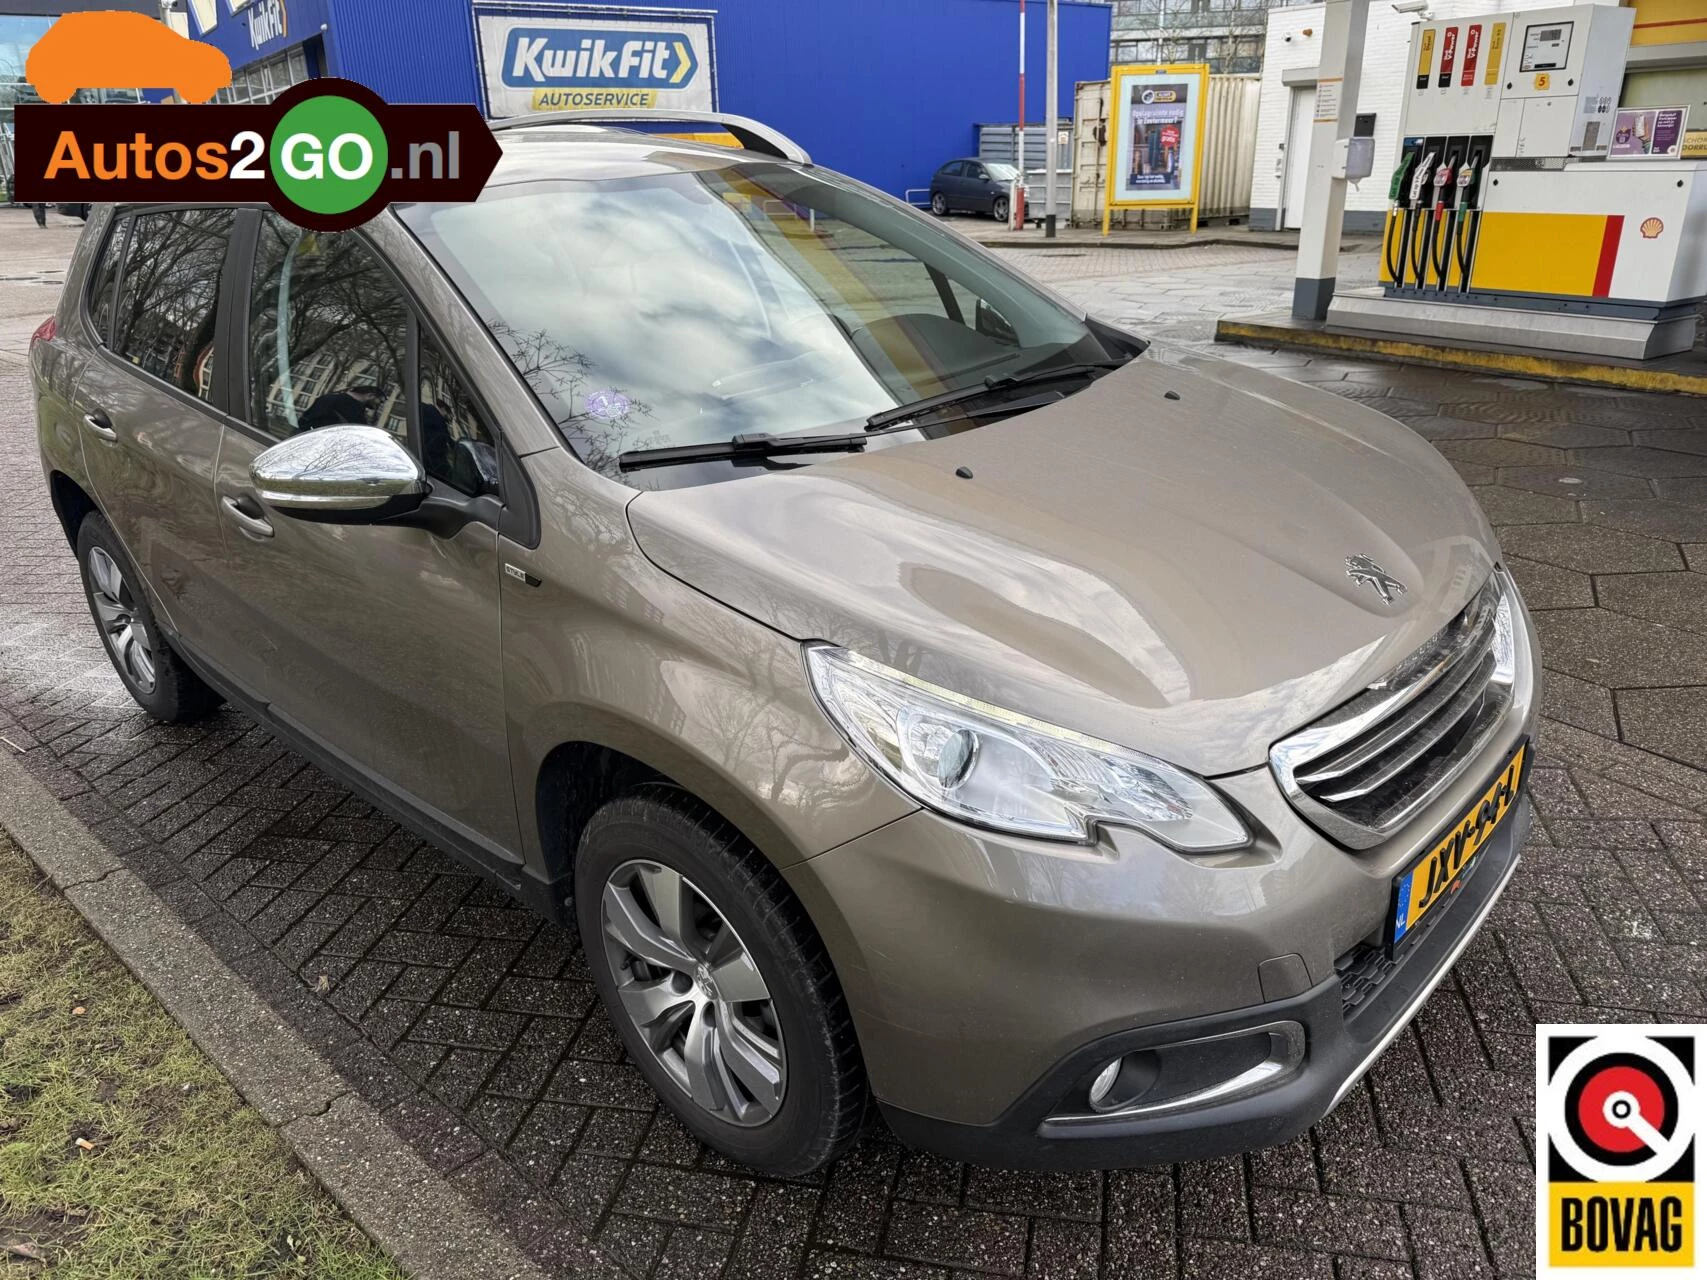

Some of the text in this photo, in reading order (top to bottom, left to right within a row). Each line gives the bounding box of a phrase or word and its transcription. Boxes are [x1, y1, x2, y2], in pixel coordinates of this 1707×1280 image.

[1538, 76, 1545, 86] 5
[539, 92, 649, 106] AUTOSERVICE
[1396, 913, 1405, 928] NL
